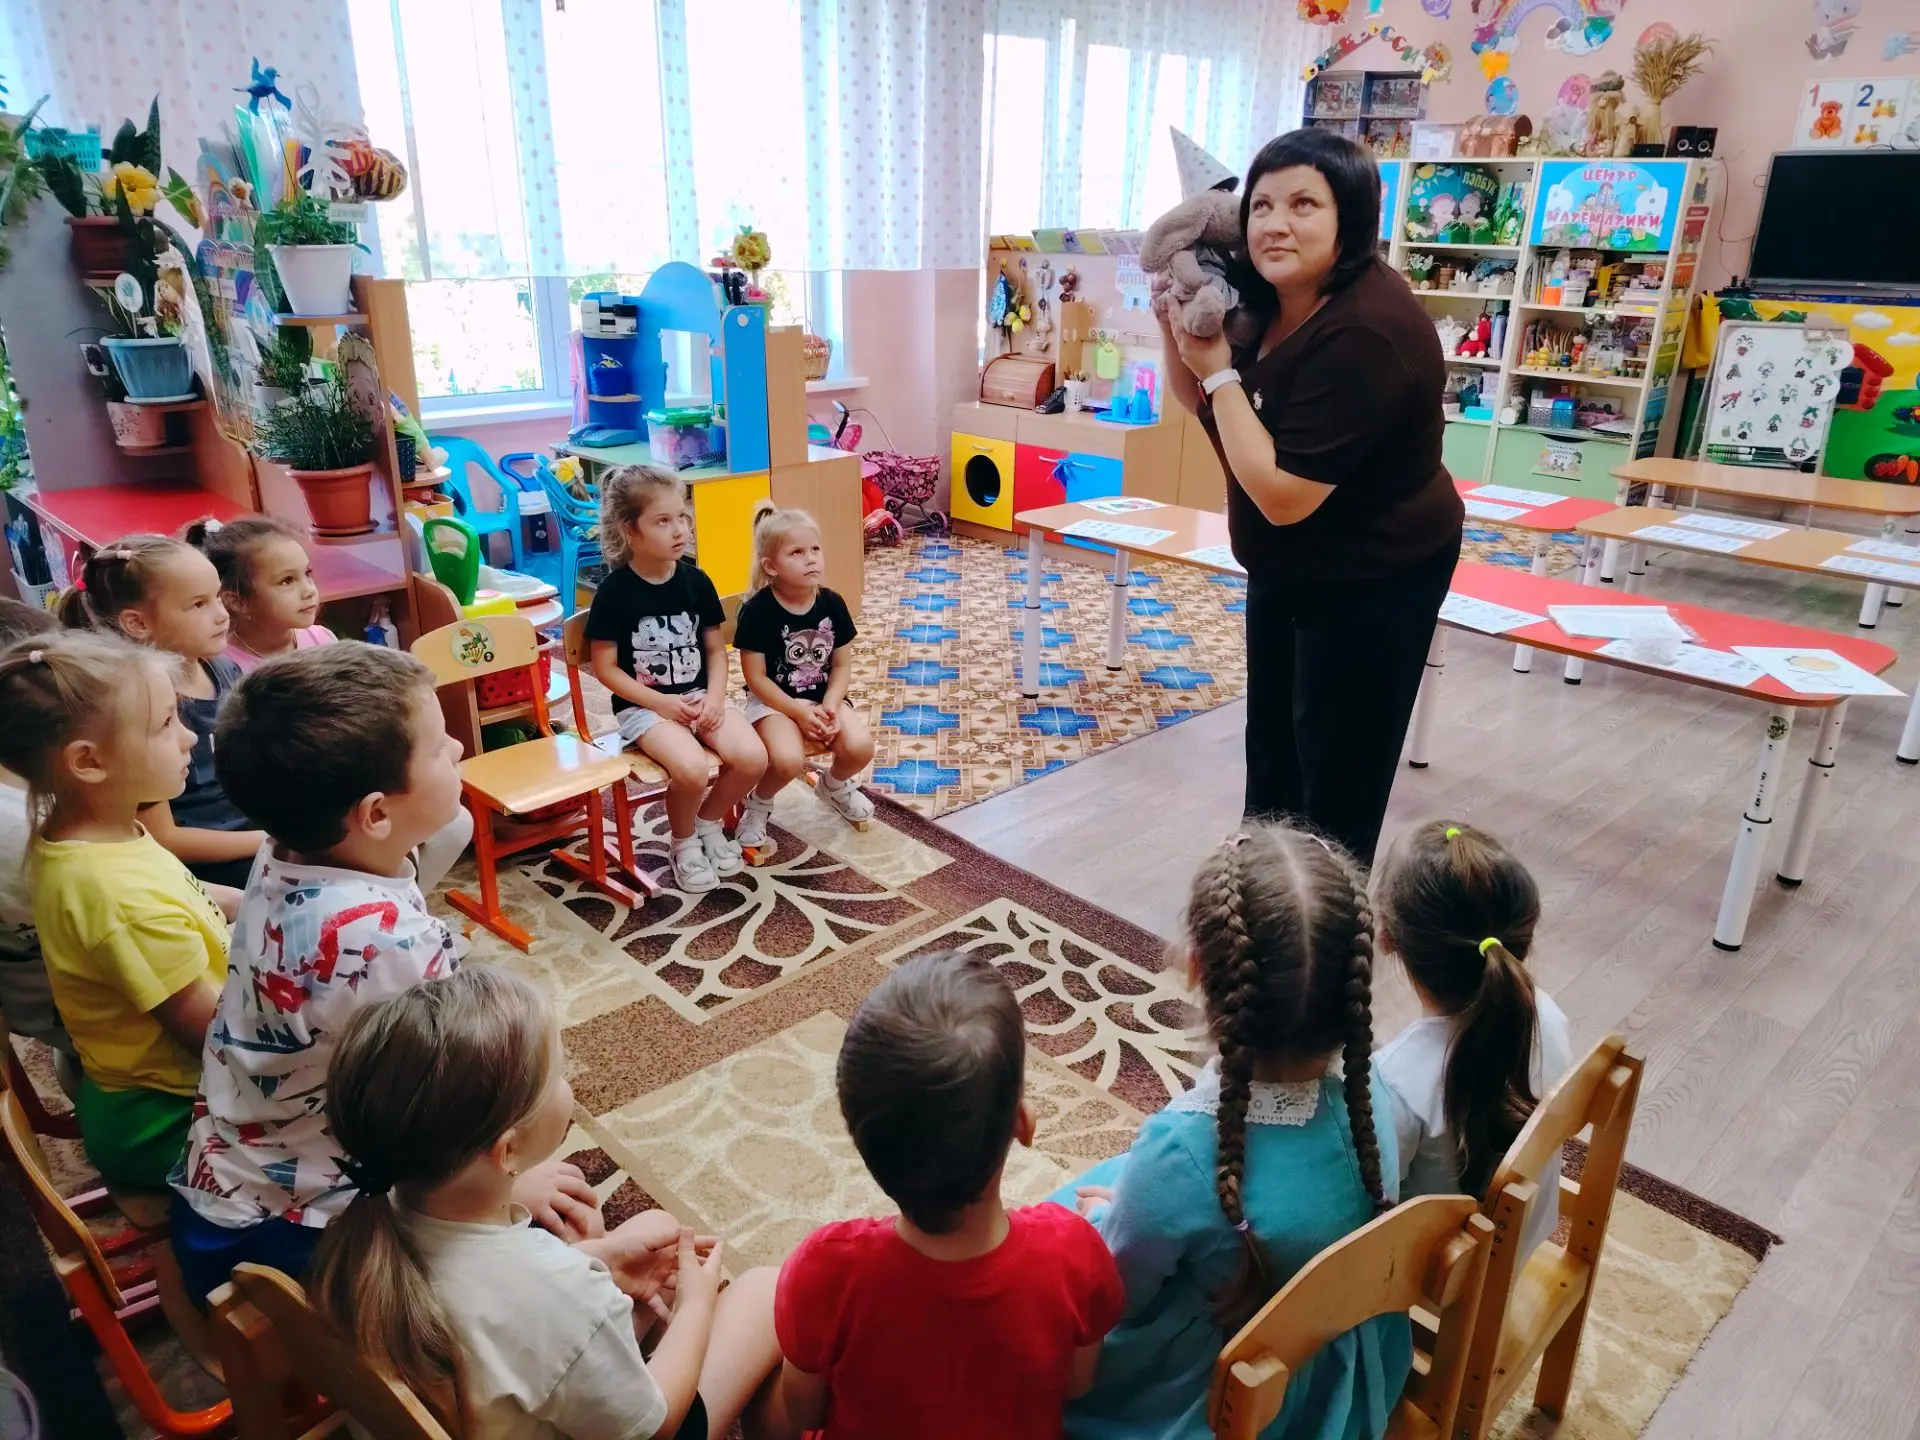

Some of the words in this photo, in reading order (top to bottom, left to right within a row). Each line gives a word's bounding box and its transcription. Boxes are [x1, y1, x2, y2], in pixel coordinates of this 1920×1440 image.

[1809, 84, 1820, 107] 1
[1857, 84, 1874, 107] 2
[1583, 168, 1638, 182] ЦЕНТР
[1546, 210, 1661, 228] МАТЕМАТИКИ
[1118, 272, 1148, 285] АППЕ
